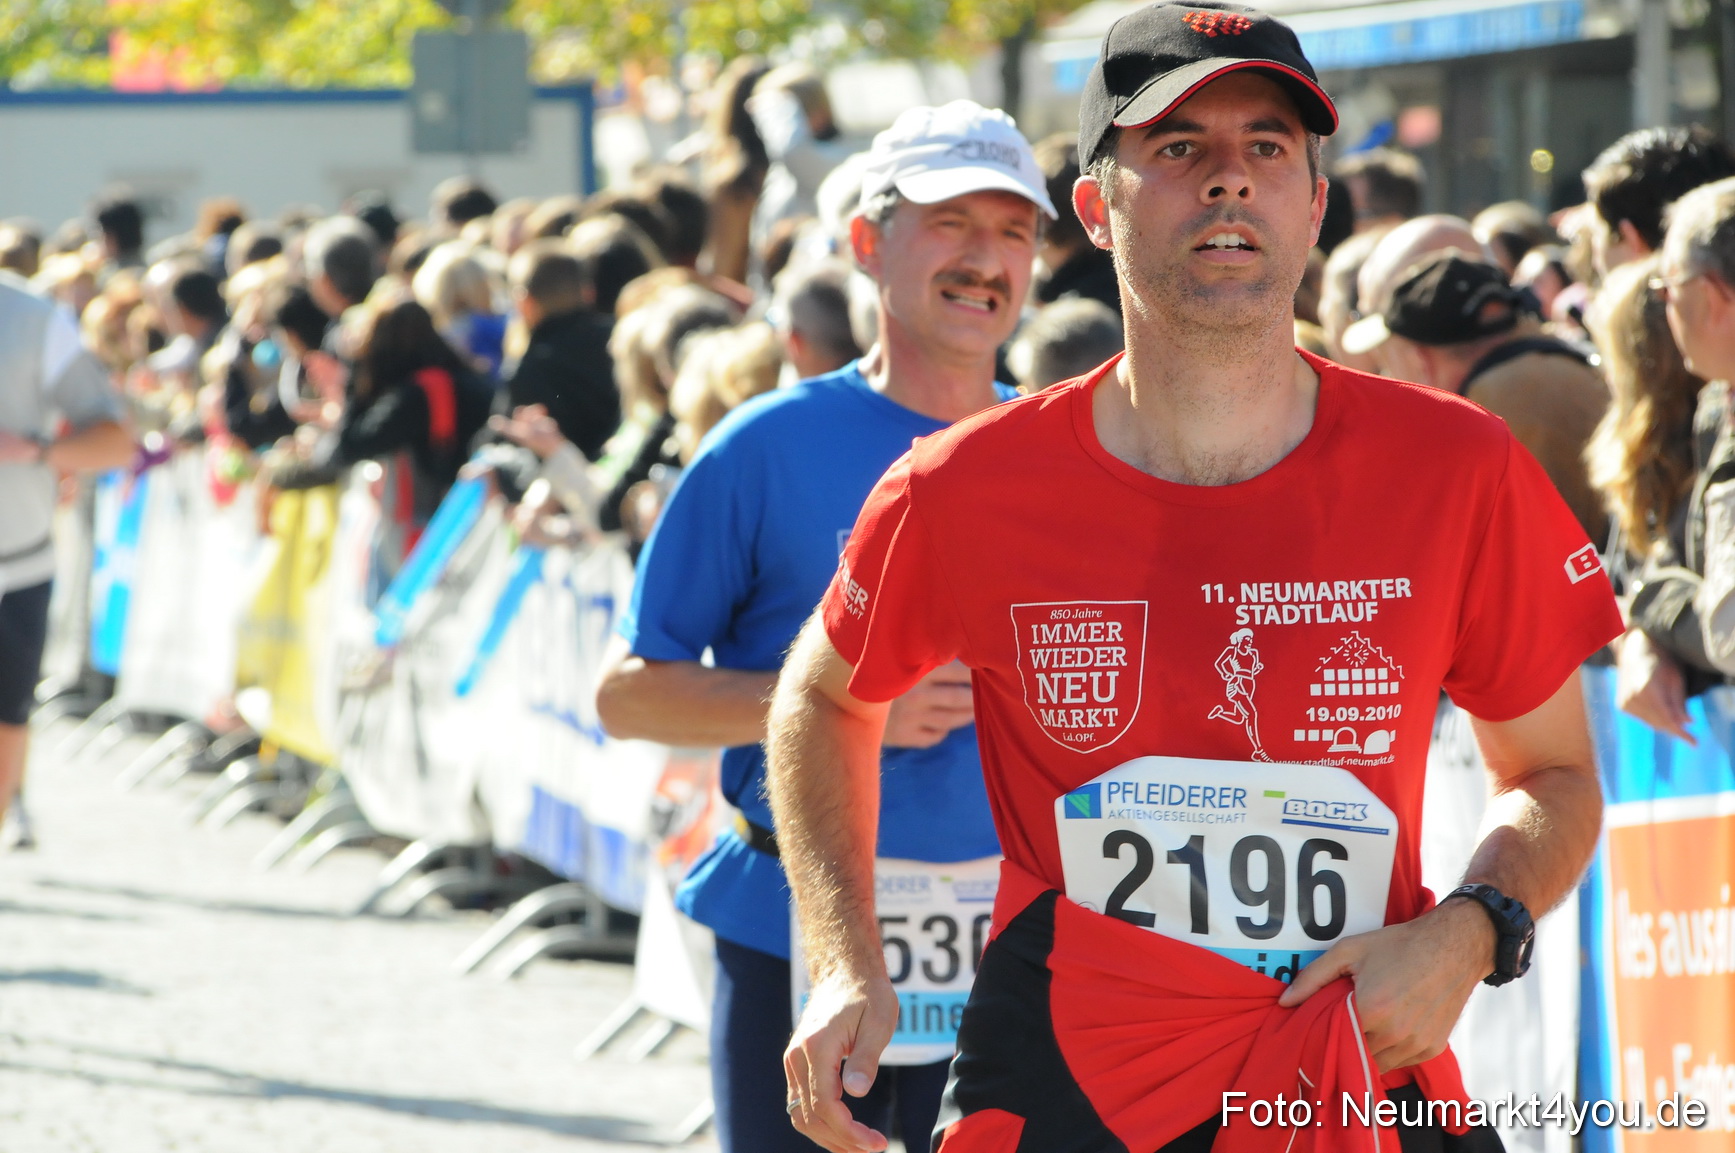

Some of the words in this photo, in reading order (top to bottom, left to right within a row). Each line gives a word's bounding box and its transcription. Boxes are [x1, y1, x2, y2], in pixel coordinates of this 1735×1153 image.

[1201, 583, 1235, 603] 11.
[1240, 578, 1412, 603] NEUMARKTER
[1050, 609, 1071, 620] 850
[1072, 608, 1103, 619] Jahre
[1235, 602, 1378, 625] STADTLAUF
[1031, 622, 1124, 644] IMMER
[1029, 647, 1128, 669] WIEDER
[1035, 671, 1119, 704] NEU
[1040, 708, 1119, 728] MARKT
[1306, 704, 1402, 721] 19.09.2010
[1107, 782, 1247, 808] PFLEIDERER
[1108, 809, 1247, 824] AKTIENGESELLSCHAFT
[1283, 799, 1368, 821] BOCK
[1102, 829, 1348, 942] 2196
